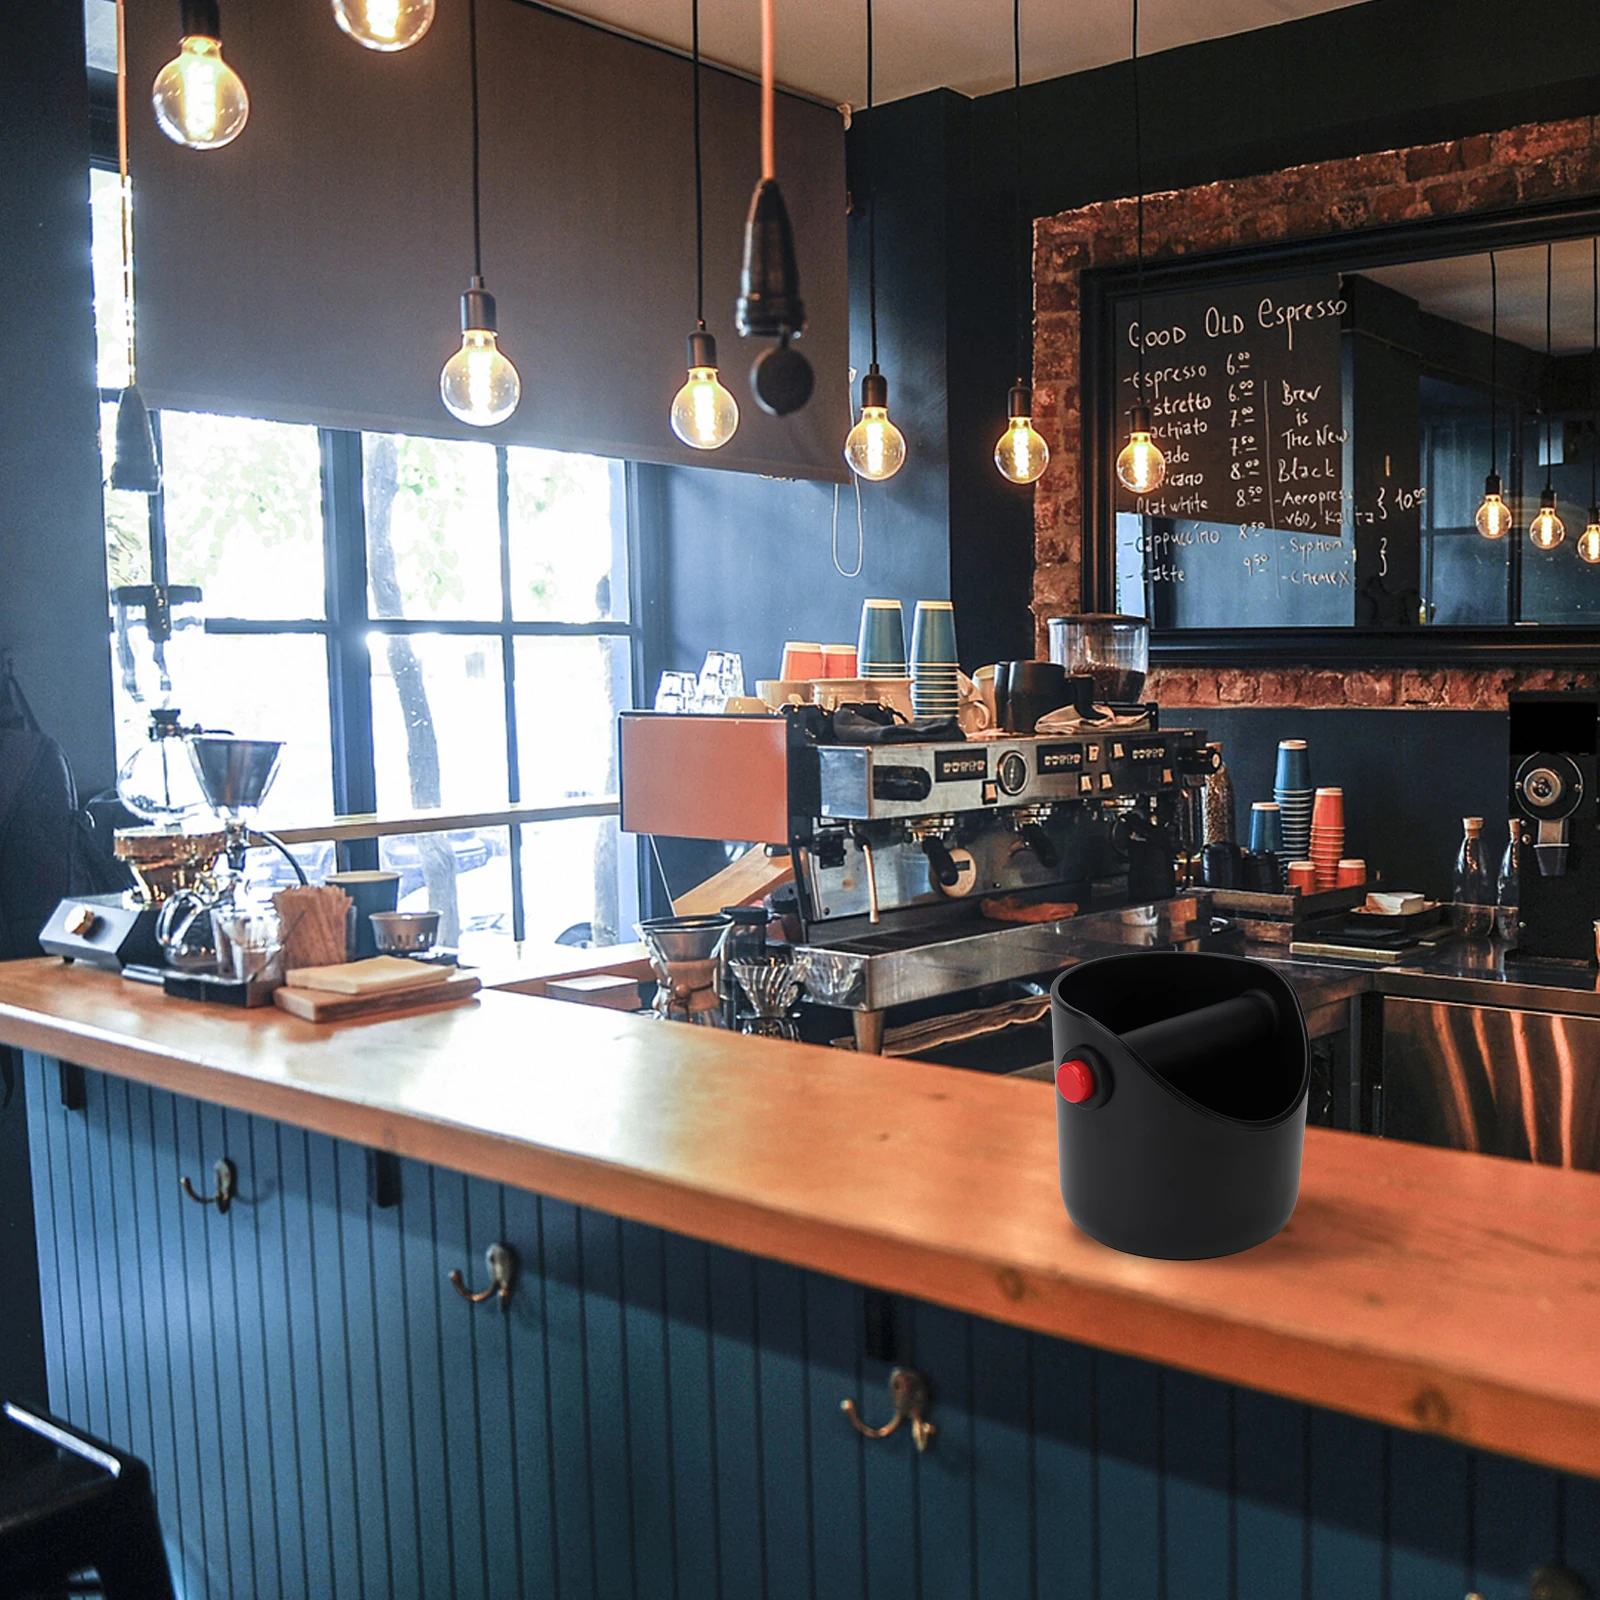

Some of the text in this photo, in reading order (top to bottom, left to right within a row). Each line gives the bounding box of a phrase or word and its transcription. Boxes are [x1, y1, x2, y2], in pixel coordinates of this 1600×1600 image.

[1128, 321, 1187, 354] GOOD
[1205, 306, 1245, 338] OLD
[1281, 380, 1322, 406] Brew
[1295, 407, 1309, 427] is
[1315, 424, 1349, 446] New
[1278, 457, 1336, 483] Black
